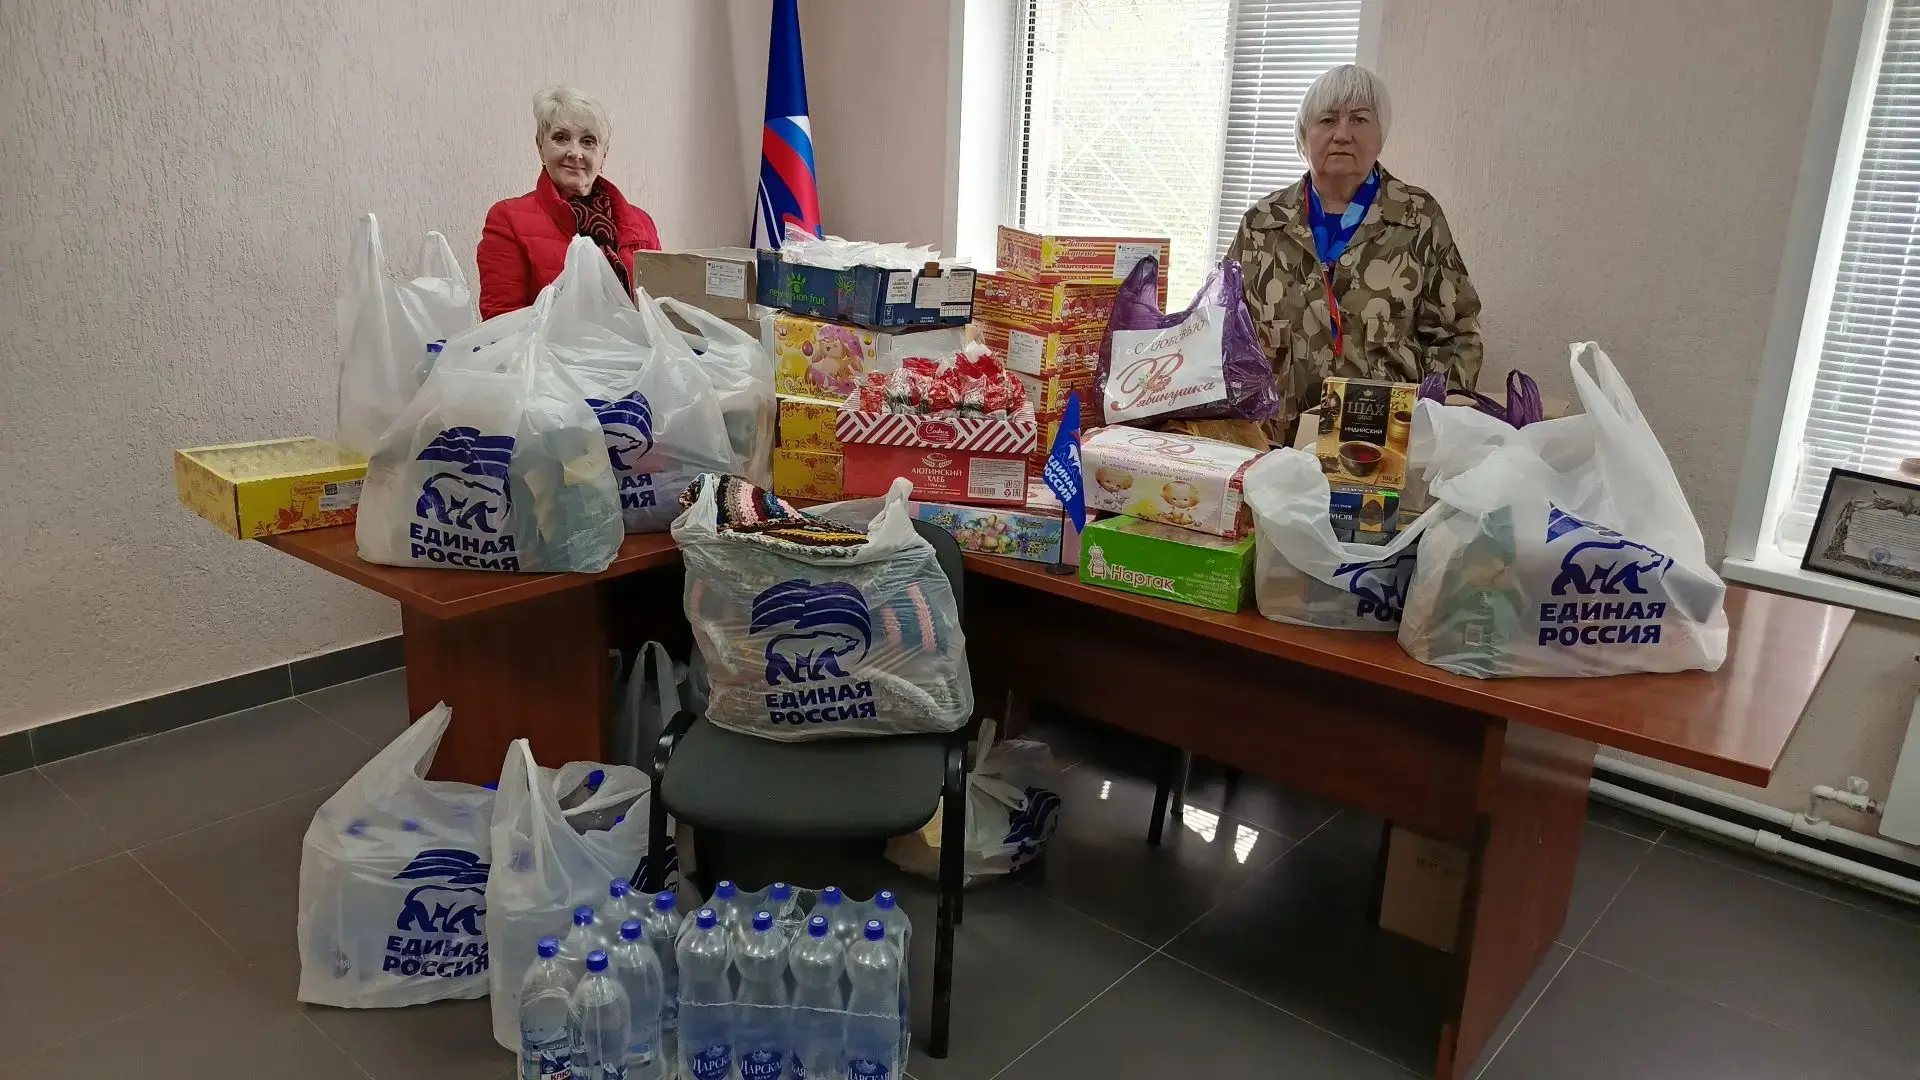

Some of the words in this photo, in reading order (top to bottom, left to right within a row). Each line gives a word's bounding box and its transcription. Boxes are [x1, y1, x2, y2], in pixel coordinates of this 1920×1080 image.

[769, 288, 784, 297] new
[810, 295, 826, 306] fruit
[1347, 401, 1386, 416] ШАХ
[1344, 426, 1383, 435] ИНДИЙСКИЙ
[410, 522, 516, 555] ЕДИНАЯ
[411, 542, 520, 572] РОССИЯ
[1111, 563, 1175, 591] Нартак
[1540, 602, 1666, 624] ЕДИНАЯ
[1538, 625, 1662, 647] РОССИЯ
[765, 681, 873, 709] ЕДИНАЯ
[769, 701, 877, 725] РОССИЯ
[383, 953, 489, 978] РОССИЯ
